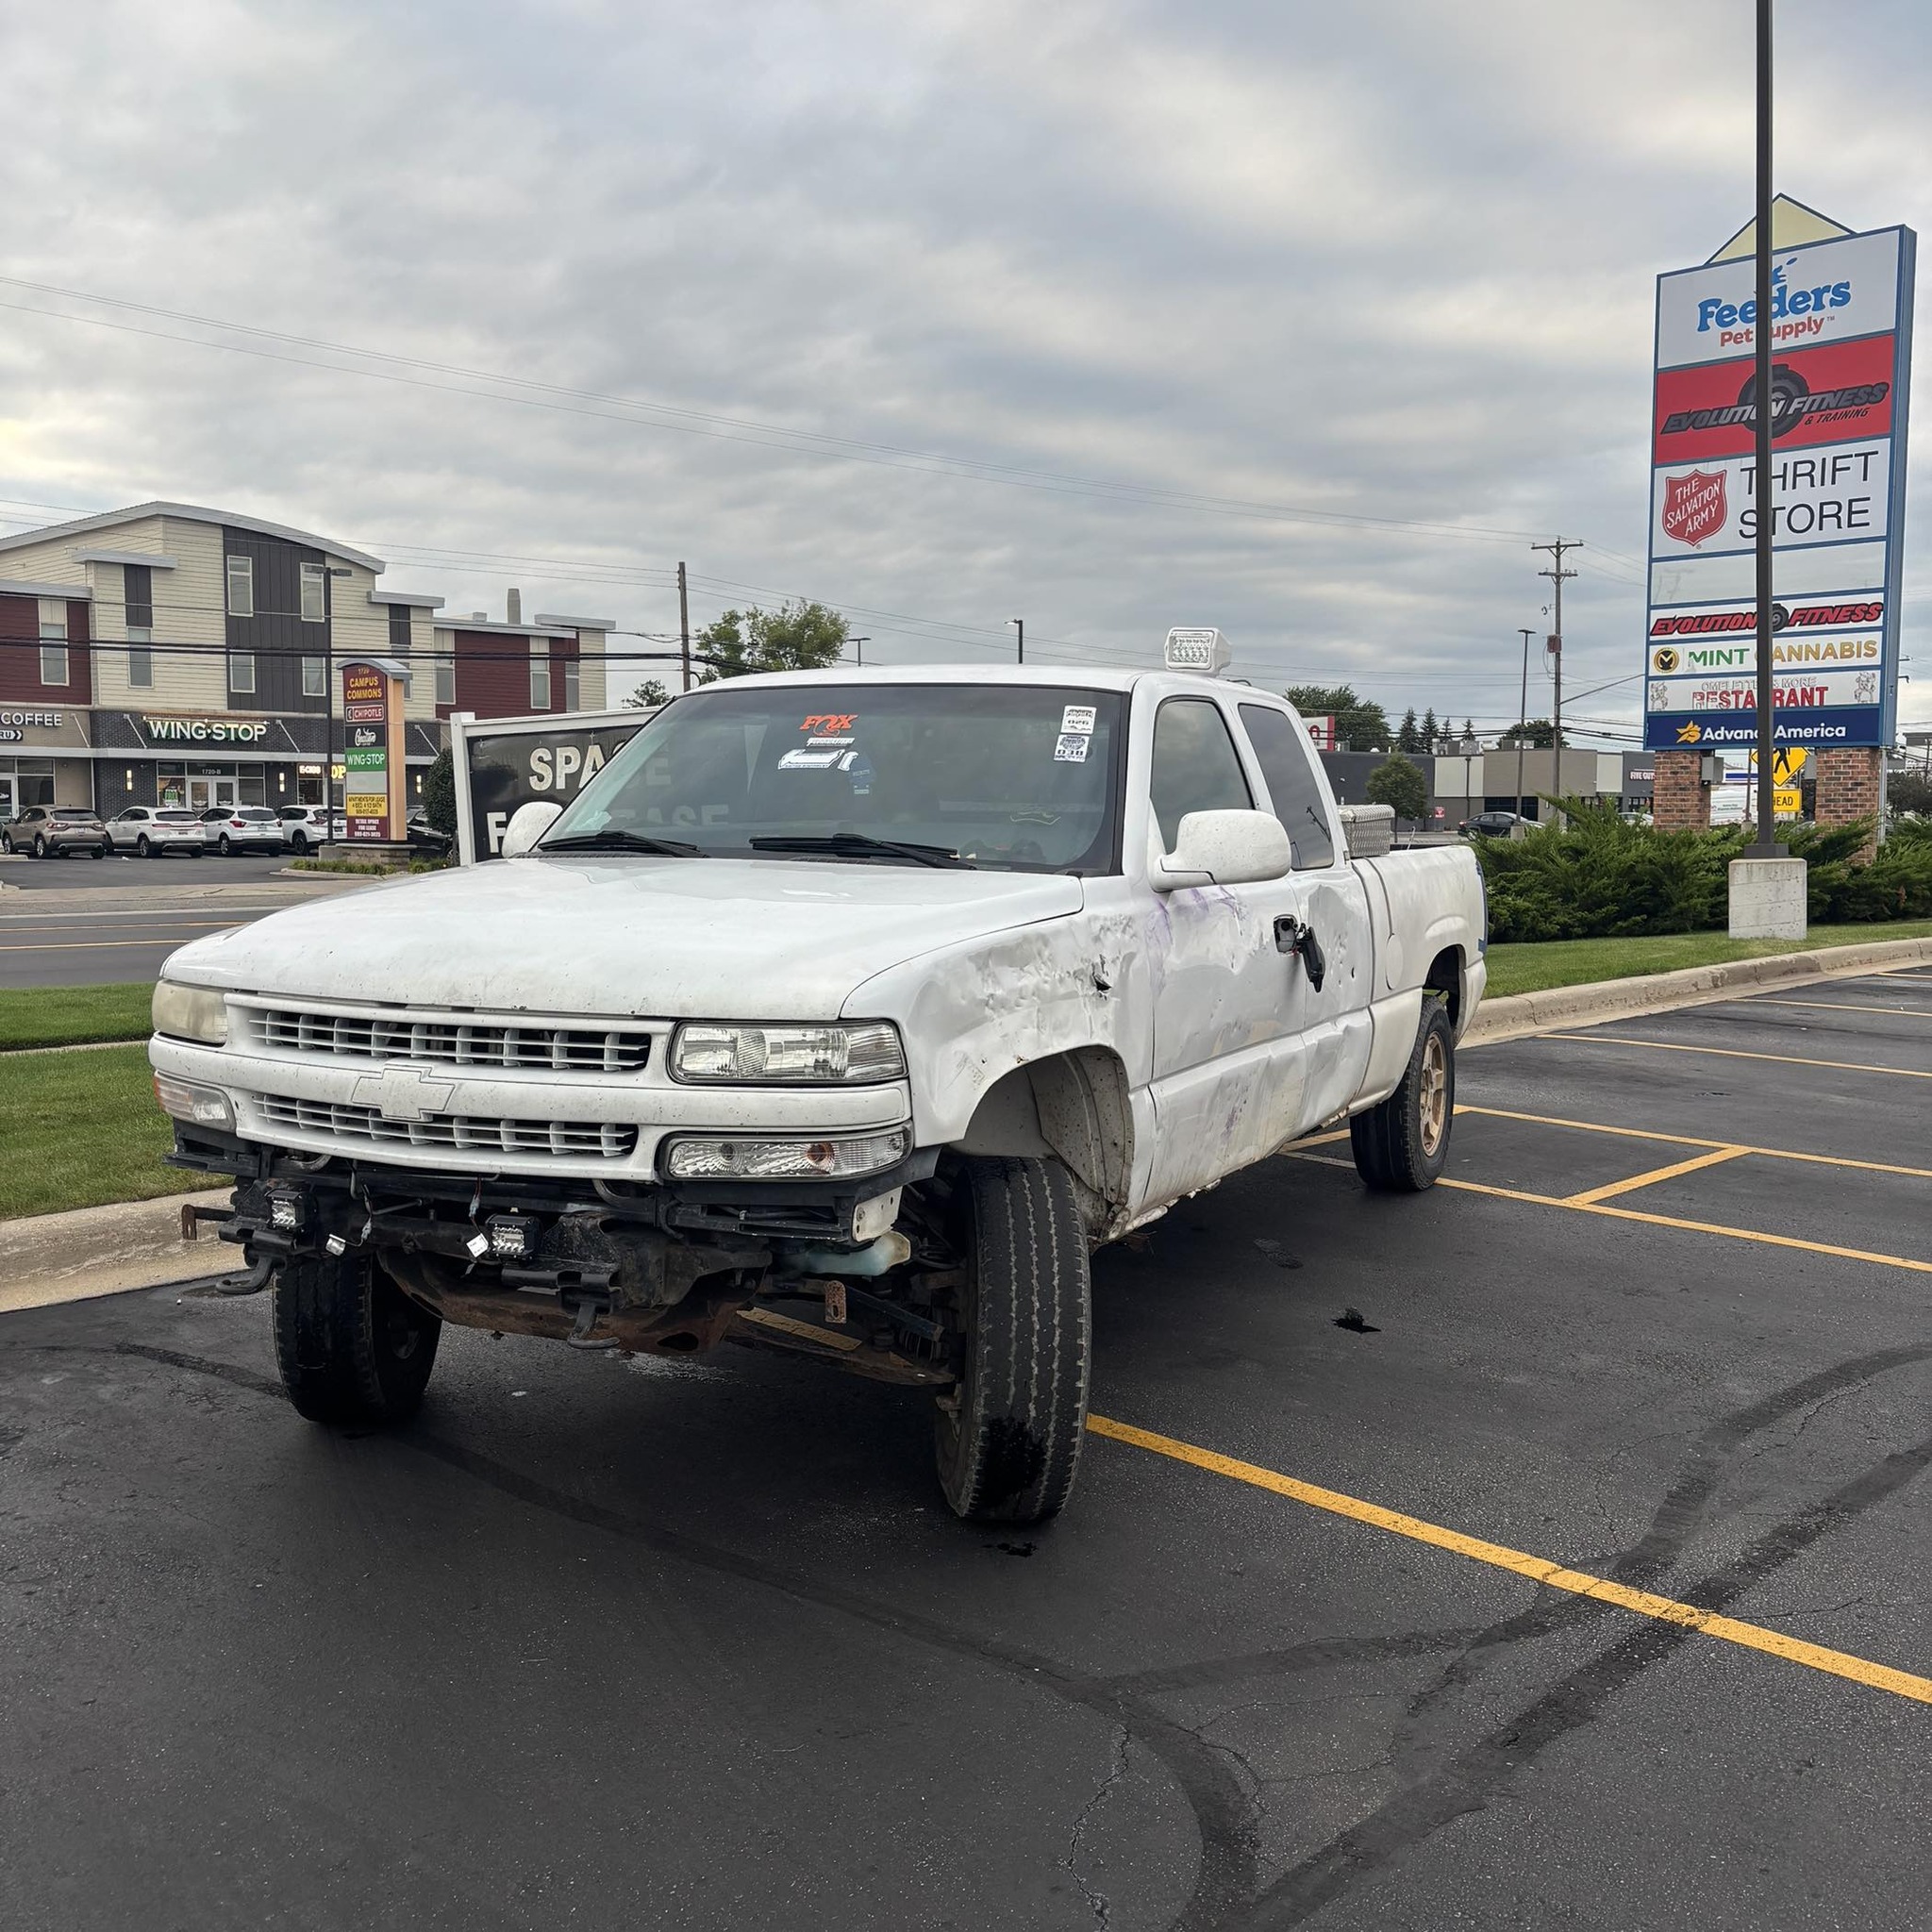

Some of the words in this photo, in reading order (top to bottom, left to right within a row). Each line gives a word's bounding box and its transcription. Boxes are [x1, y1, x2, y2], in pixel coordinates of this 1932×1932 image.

[1697, 280, 1852, 332] Feeders
[1720, 327, 1754, 346] Pet
[1770, 316, 1824, 341] upply
[1787, 382, 1889, 415] FITNESS
[1805, 416, 1812, 425] &
[1816, 408, 1870, 424] TRAINING
[1740, 450, 1879, 495] THRIFT
[1667, 478, 1722, 529] SALVATION
[1675, 478, 1700, 504] THE
[1684, 500, 1719, 538] ARMY
[1739, 496, 1871, 539] STORE
[1651, 611, 1757, 636] EVOLUTION
[1788, 602, 1884, 627] FITNESS
[1689, 648, 1750, 667] MINT
[1755, 640, 1878, 662] ANNABIS
[347, 689, 382, 700] COMMONS
[349, 676, 378, 688] CAMPUS
[1692, 687, 1828, 709] RESTARANT
[1, 712, 62, 725] COFFEE
[354, 708, 382, 718] CHIPOTLE
[799, 714, 858, 737] FOX
[1774, 723, 1846, 739] America
